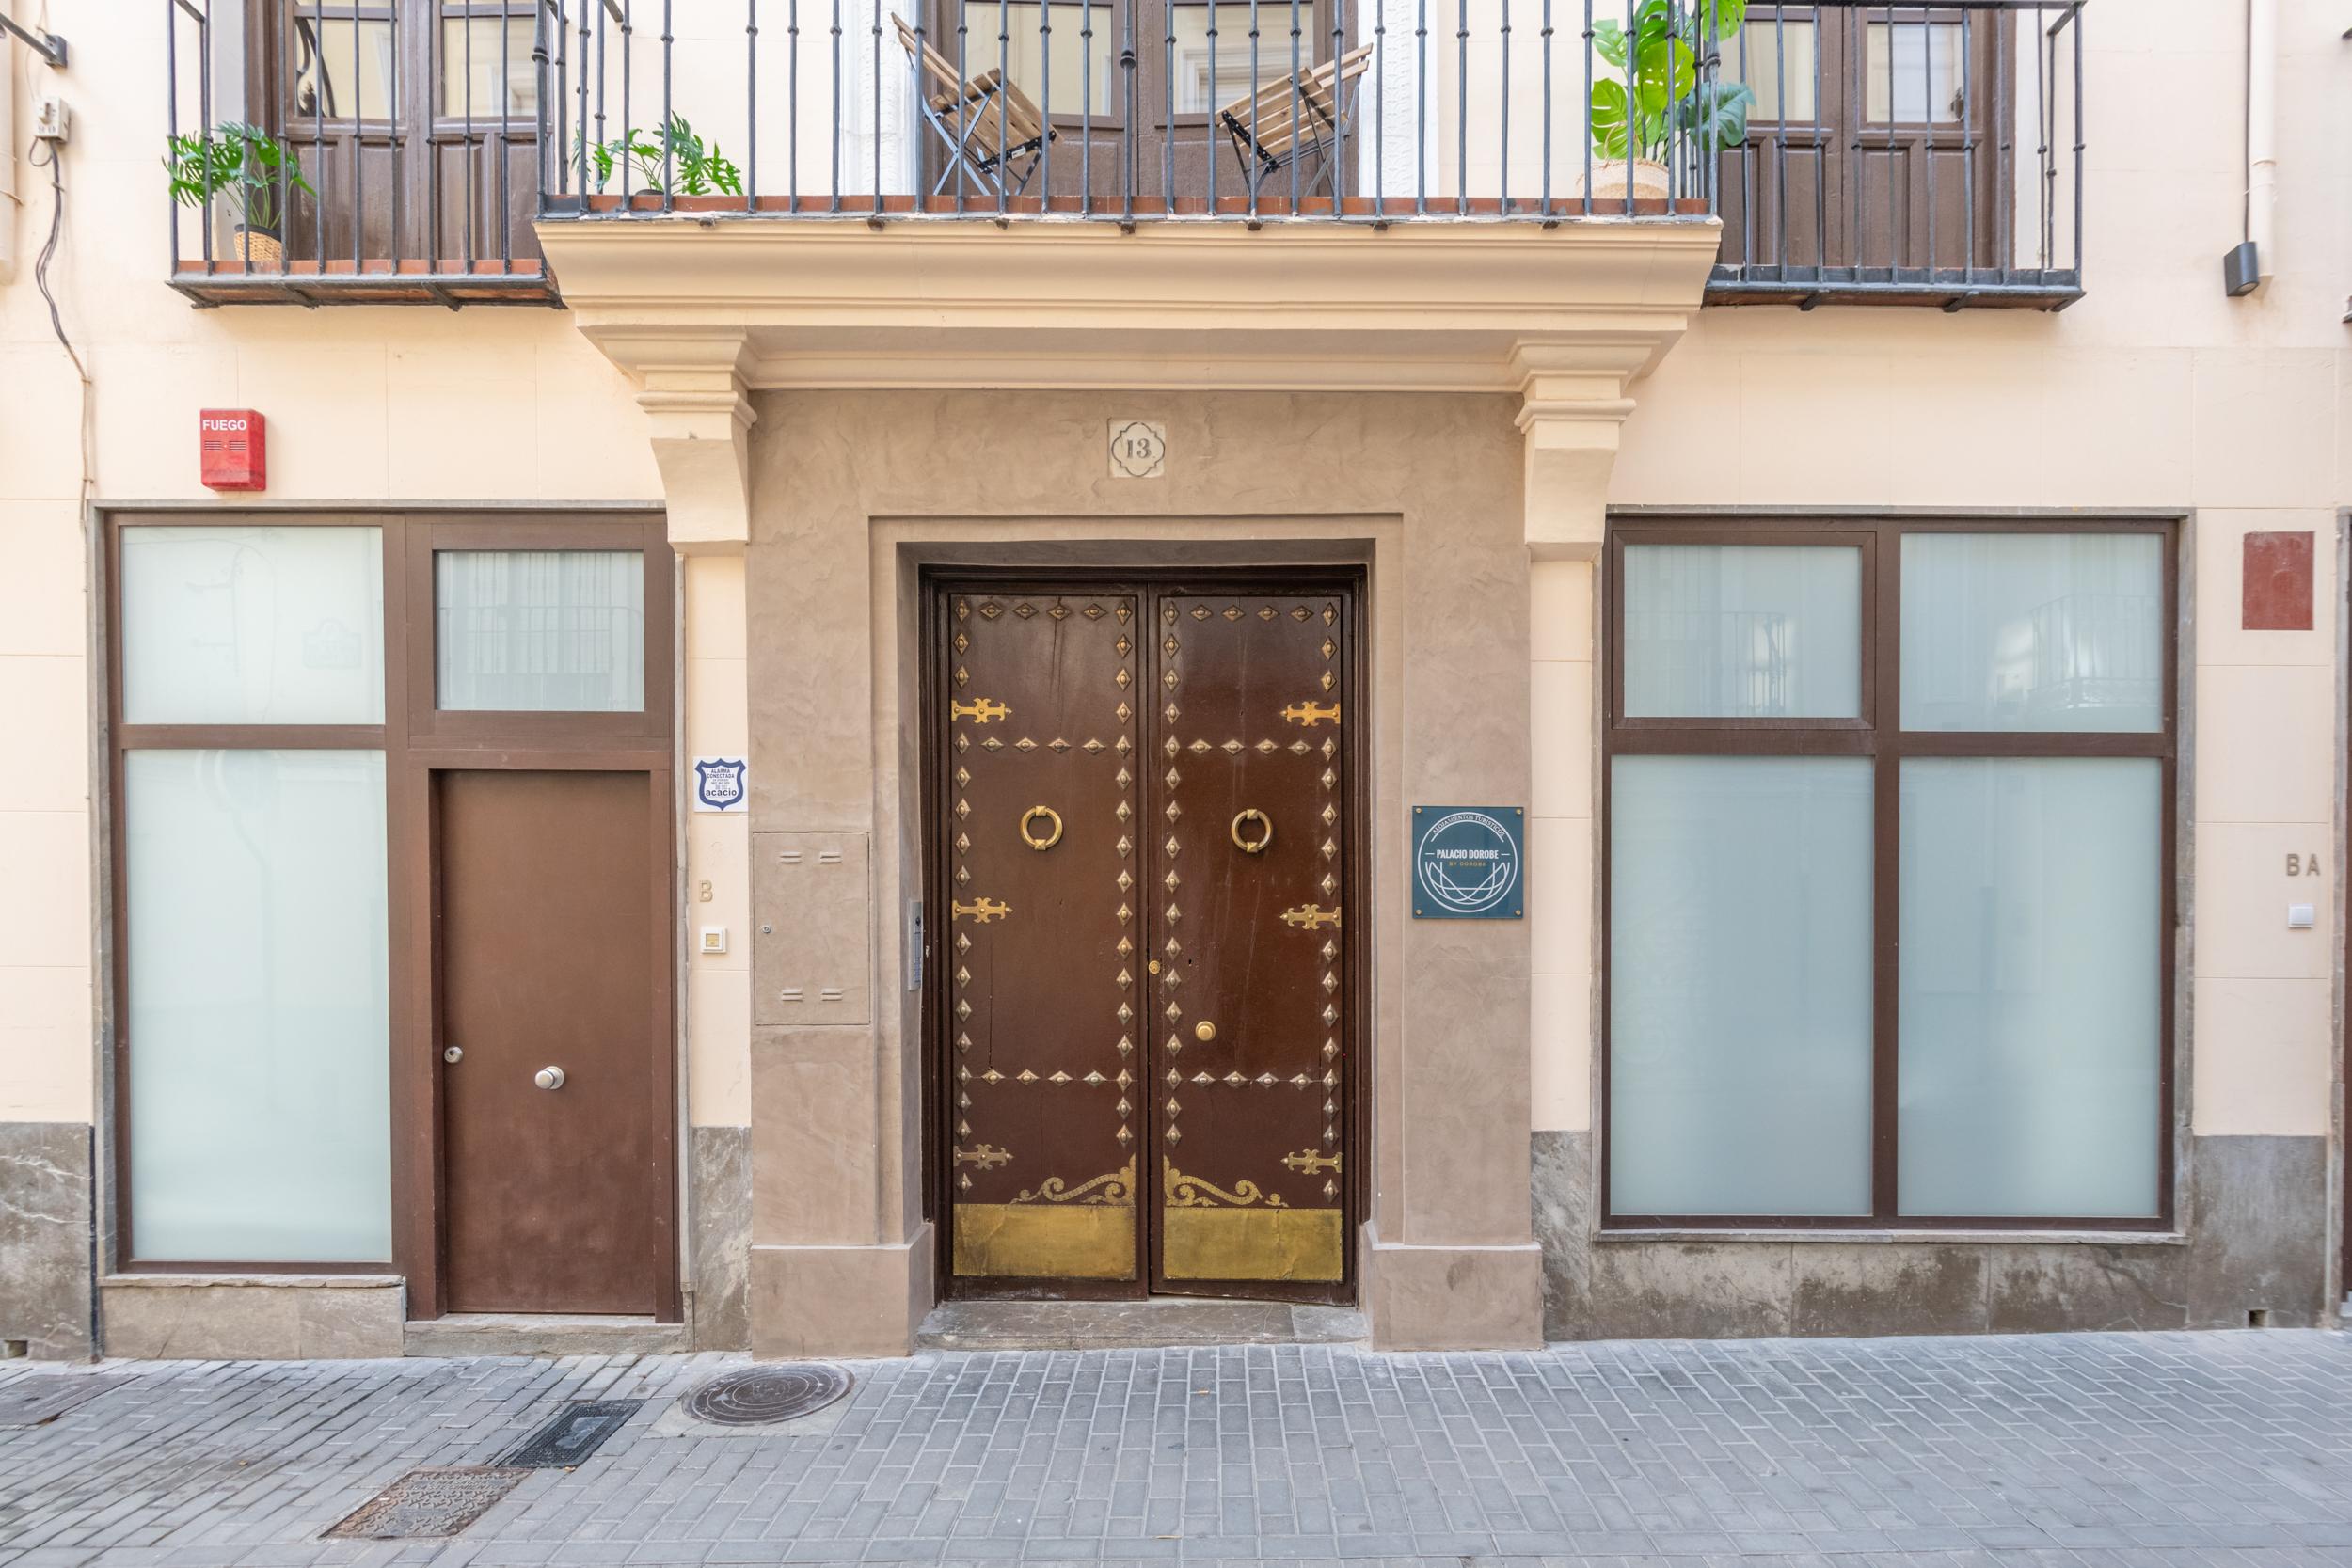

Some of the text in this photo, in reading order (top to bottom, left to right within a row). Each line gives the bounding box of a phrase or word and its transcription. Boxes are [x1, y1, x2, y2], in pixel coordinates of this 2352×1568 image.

[202, 420, 246, 431] FUEGO
[1127, 438, 1152, 458] 13
[1432, 814, 1473, 834] ALOJAMIENTOS
[1437, 849, 1499, 860] PALACIO DOROBE
[700, 880, 713, 902] B
